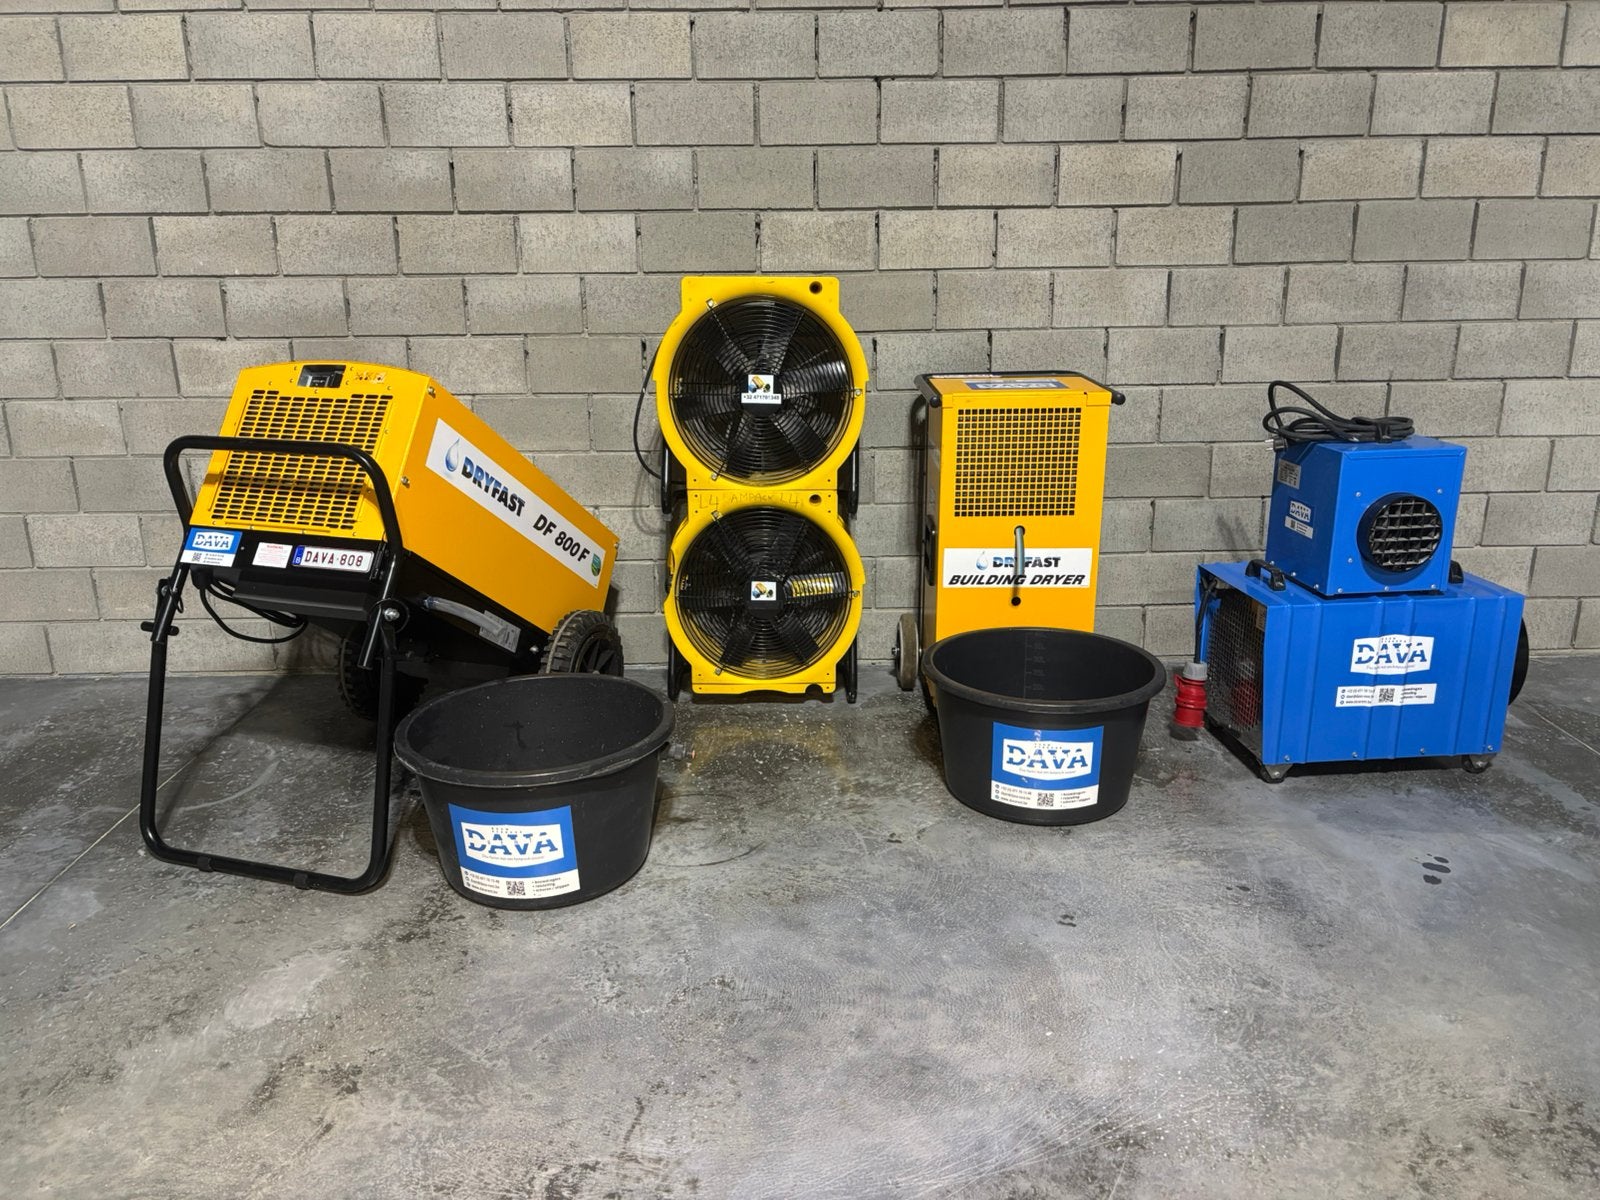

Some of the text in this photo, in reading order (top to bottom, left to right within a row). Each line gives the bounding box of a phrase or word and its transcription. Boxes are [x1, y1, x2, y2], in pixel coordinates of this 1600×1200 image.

[461, 456, 590, 562] DRYFAST DF 800 F
[1290, 502, 1310, 521] DAVA
[195, 533, 230, 549] DAVA
[992, 556, 1062, 568] DRFAST
[948, 574, 1086, 586] BUILDING DRYER
[1354, 641, 1428, 665] DAVA
[1006, 744, 1089, 770] DAVA
[465, 828, 559, 856] DAVA
